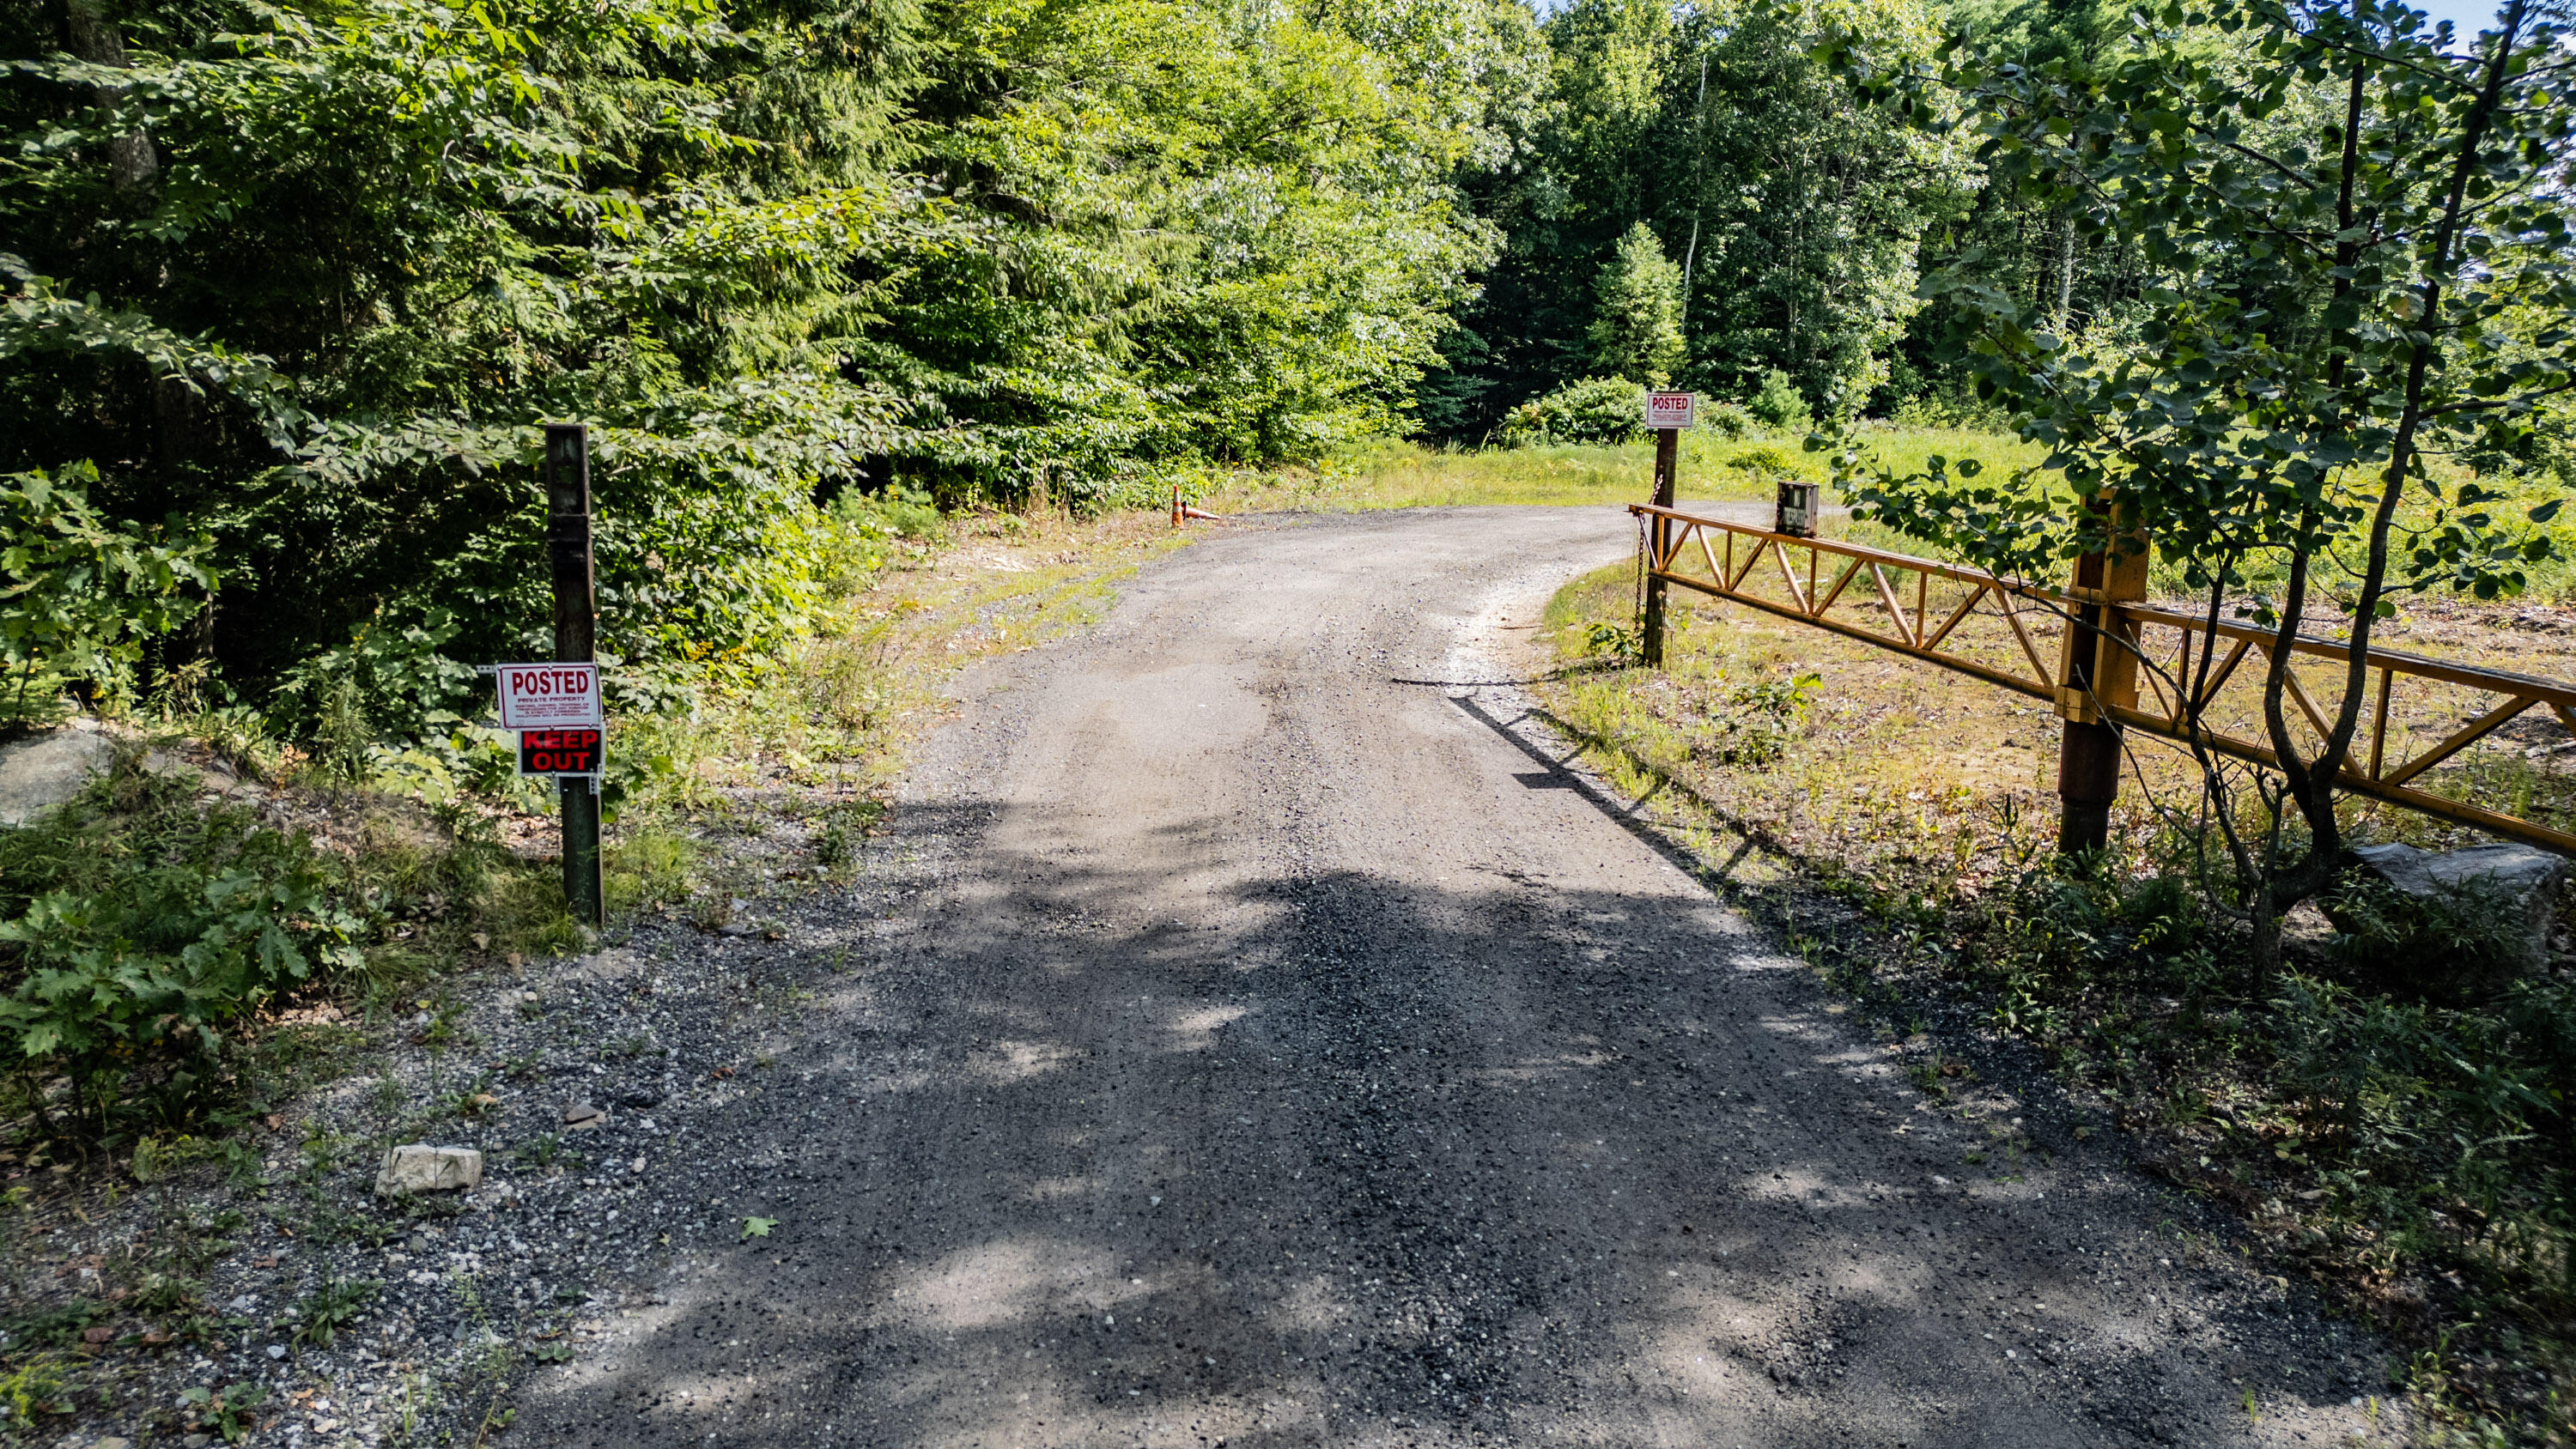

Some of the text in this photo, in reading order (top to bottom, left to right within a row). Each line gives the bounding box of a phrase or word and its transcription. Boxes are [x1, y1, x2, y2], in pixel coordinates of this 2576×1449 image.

[1653, 397, 1687, 409] POSTED
[512, 671, 588, 695] POSTED
[523, 731, 598, 749] KEEP
[532, 752, 590, 770] OUT
